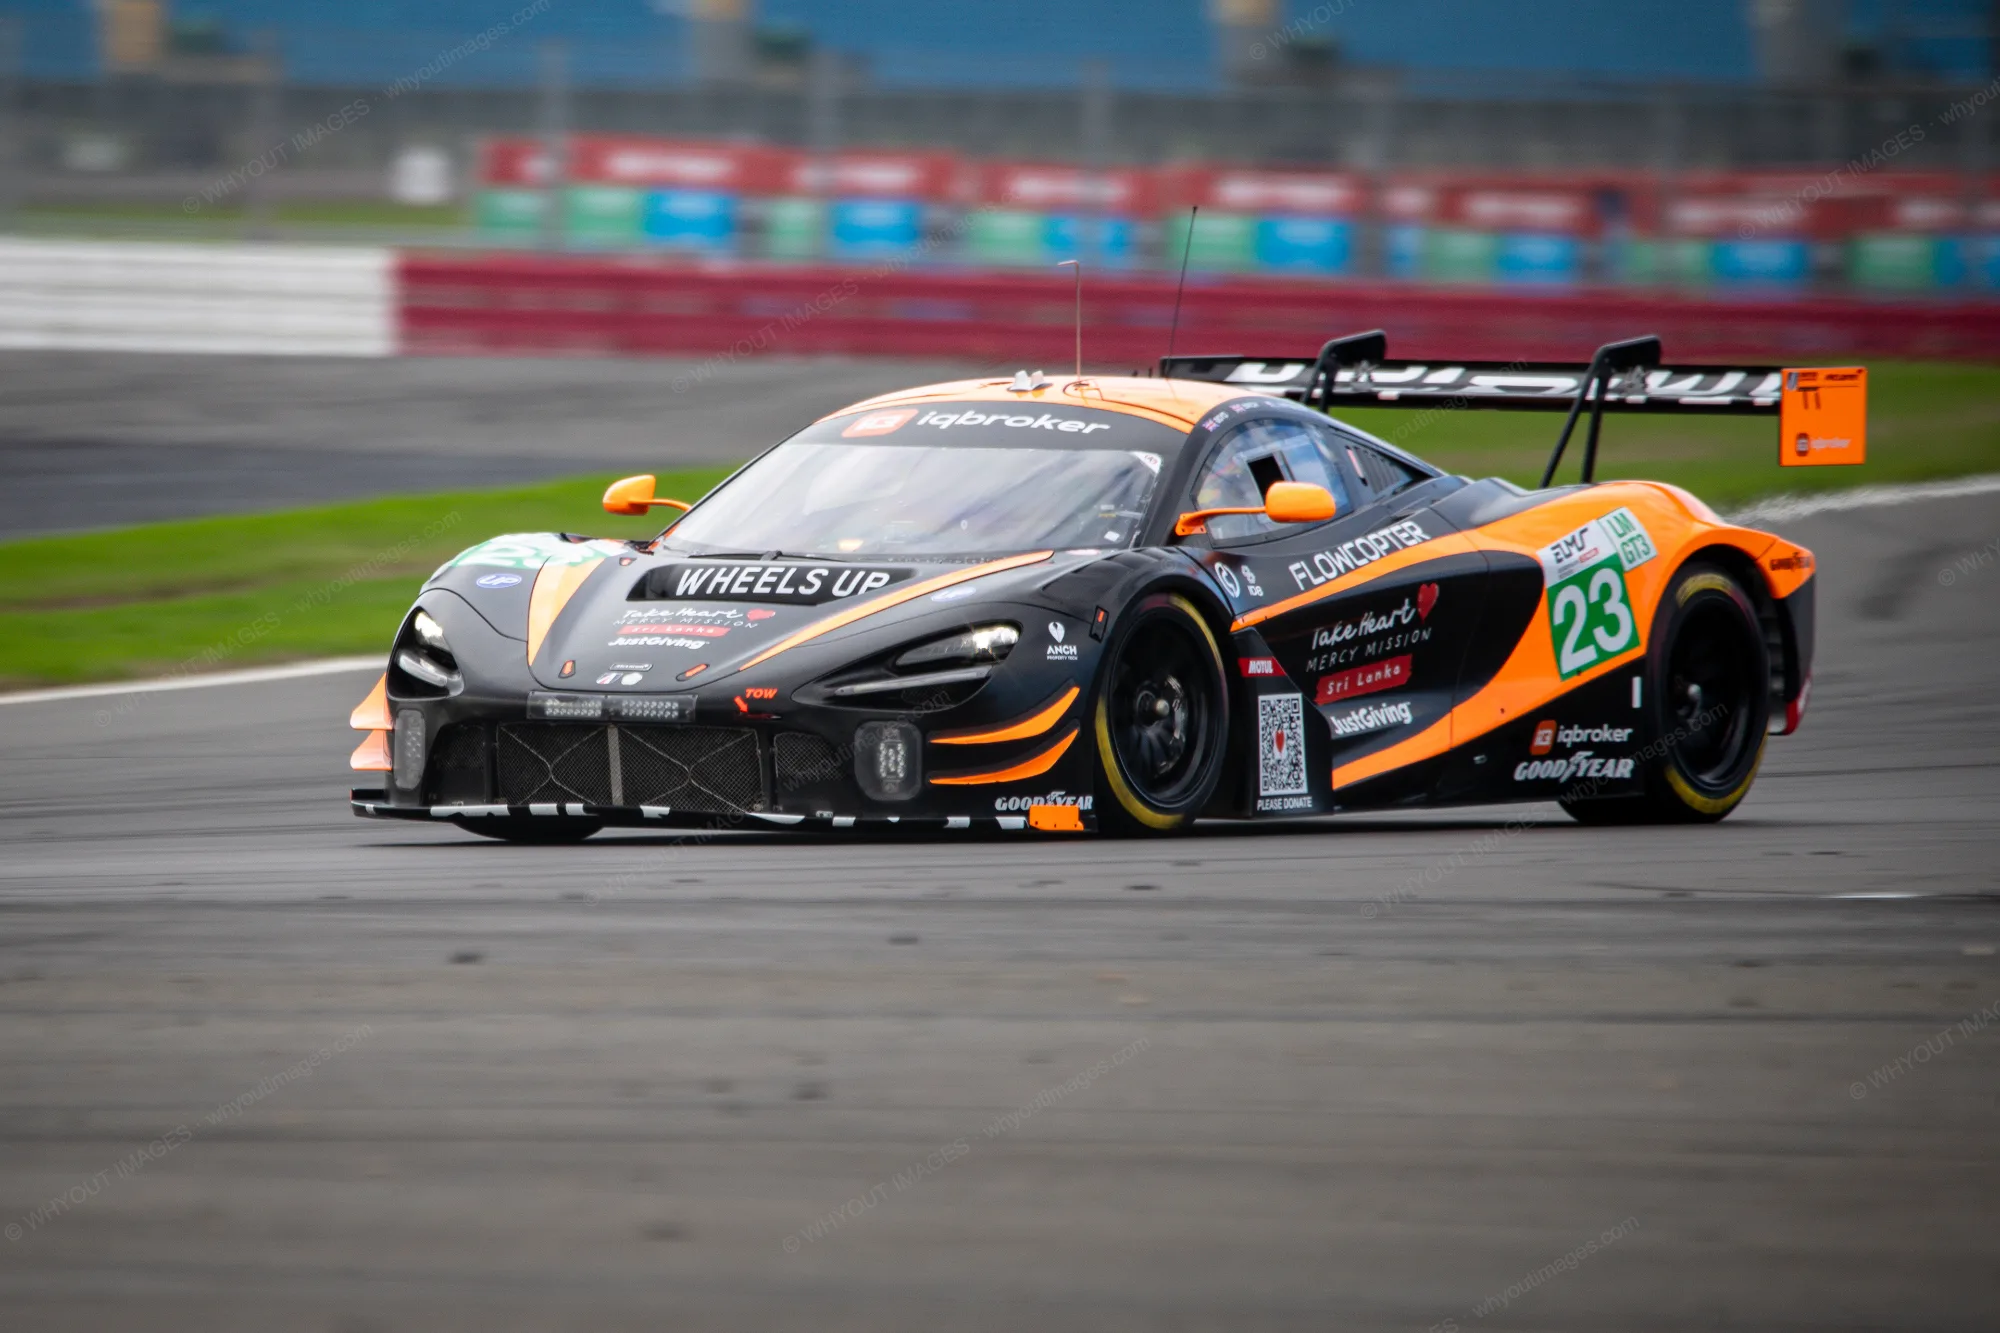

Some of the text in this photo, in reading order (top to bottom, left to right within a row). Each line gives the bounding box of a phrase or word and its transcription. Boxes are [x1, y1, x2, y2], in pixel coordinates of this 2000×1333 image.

[917, 410, 1111, 435] iqbroker
[1288, 520, 1431, 590] FLOWCOPTER
[1620, 533, 1650, 565] GT3
[675, 566, 890, 598] WHEELS UP
[612, 617, 758, 629] MERCY MISSION
[622, 607, 743, 619] Take Heart
[1311, 597, 1416, 651] Take Heart
[1552, 567, 1633, 675] 23
[608, 636, 706, 650] JustGiving
[1046, 644, 1078, 656] ANCH
[1305, 627, 1432, 673] MERCY MISSION
[1248, 659, 1274, 674] MOTUL
[1326, 664, 1401, 695] Sri Lanka
[745, 687, 778, 699] TOW
[1330, 701, 1413, 735] JustGiving
[1556, 723, 1633, 748] iqbroker
[1513, 750, 1635, 783] GOODYEAR
[1257, 796, 1313, 811] PLEASE DONATE
